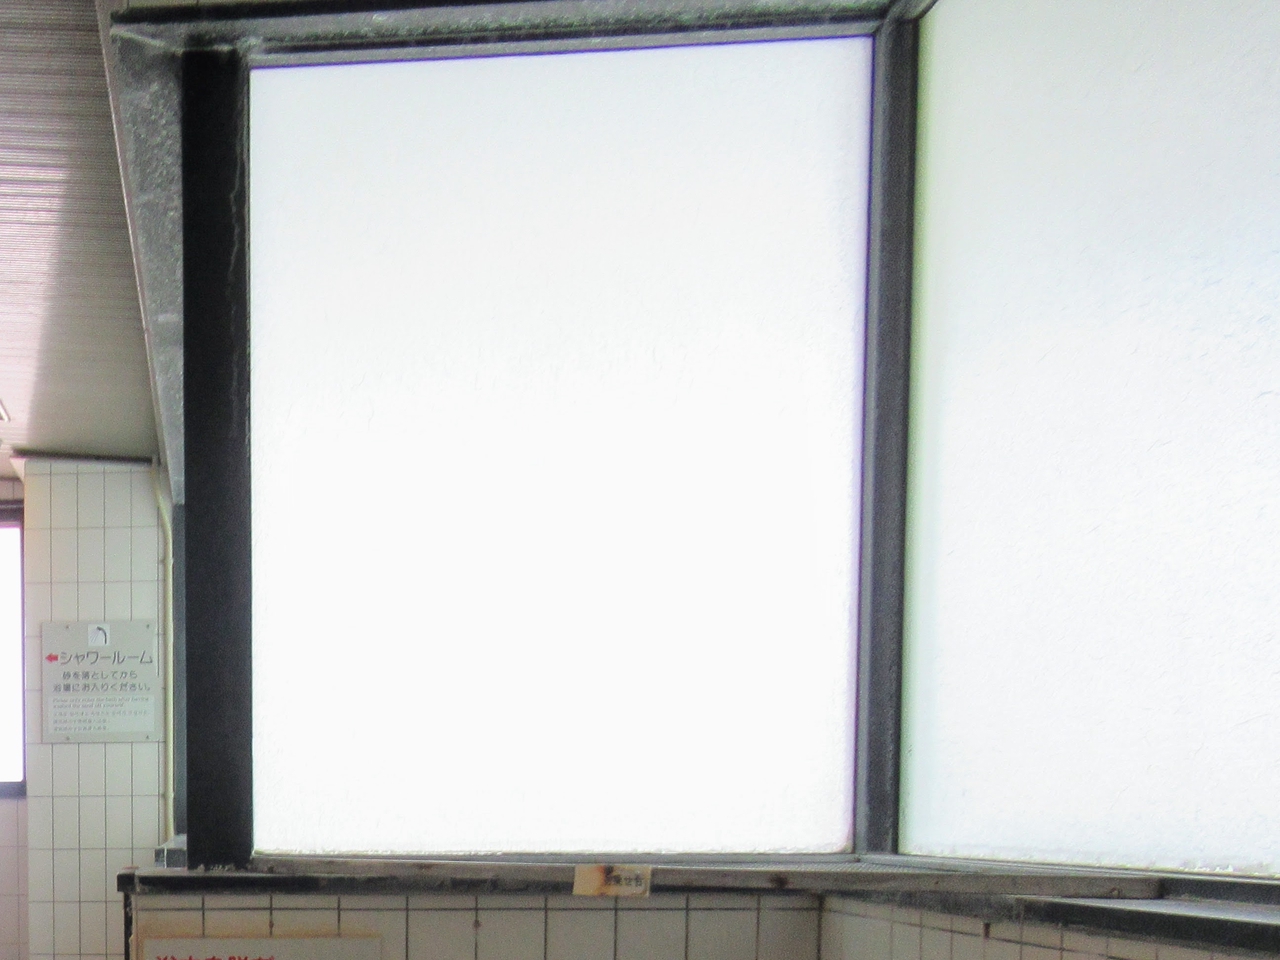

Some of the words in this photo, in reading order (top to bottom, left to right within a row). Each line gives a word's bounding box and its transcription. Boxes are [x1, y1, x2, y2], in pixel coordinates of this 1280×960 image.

[60, 650, 153, 665] シャワールーム
